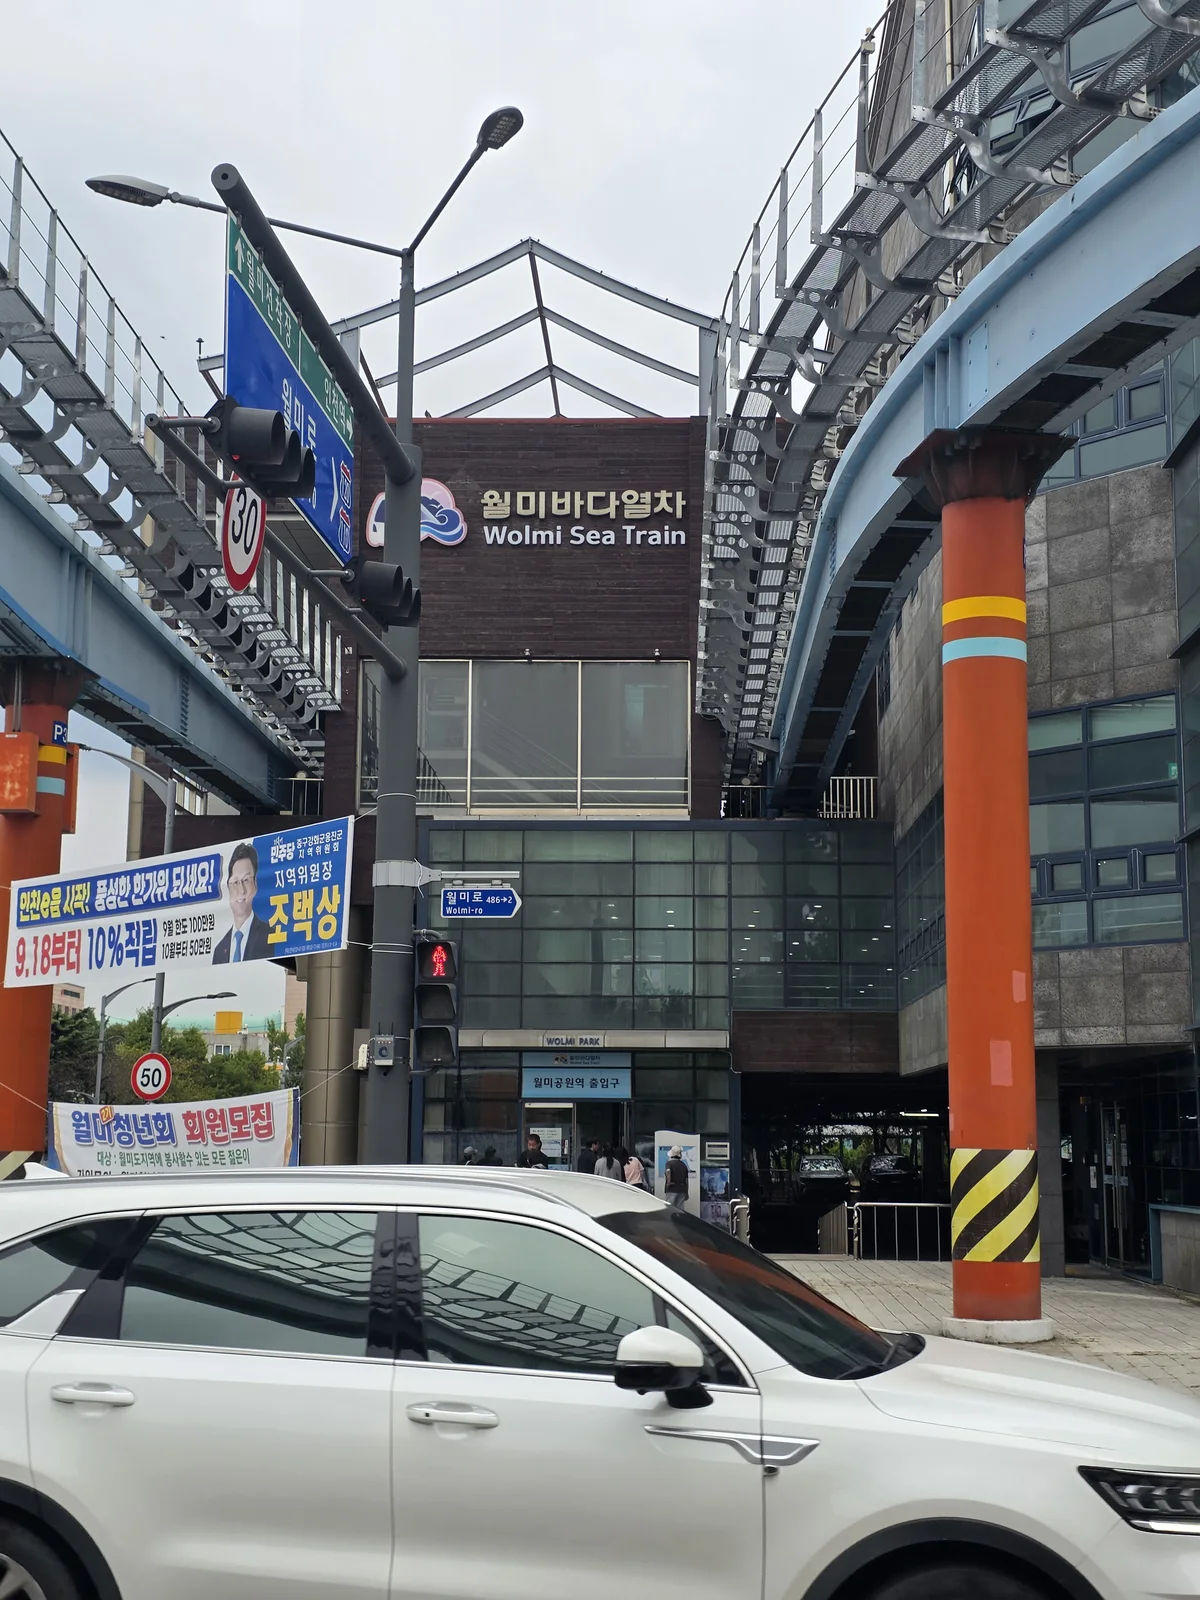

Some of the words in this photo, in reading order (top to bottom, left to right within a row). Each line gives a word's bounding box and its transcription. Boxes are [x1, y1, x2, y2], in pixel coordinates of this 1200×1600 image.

[325, 378, 346, 435] 인천역
[481, 489, 687, 520] 월미바다열차
[231, 487, 258, 556] 30
[483, 525, 562, 546] Wolmi
[569, 525, 616, 546] Sea
[622, 525, 687, 546] Train
[270, 841, 295, 864] 민주당
[298, 842, 340, 859] 지역위원회
[275, 860, 333, 889] 지역위원장
[19, 886, 62, 923] 인천e음
[63, 881, 91, 917] 시작!
[94, 874, 131, 912] 풍성한
[131, 868, 170, 905] 한가위
[170, 859, 215, 899] 되세요!
[446, 891, 483, 905] 월미로
[486, 896, 500, 904] 486
[267, 884, 341, 945] 조택상
[446, 906, 483, 915] Wolmi-ro
[162, 921, 174, 938] 9월
[175, 919, 188, 935] 한도
[188, 913, 215, 934] 100만원
[15, 928, 82, 978] 9.18부터
[88, 917, 157, 970] 10%적립
[161, 940, 188, 960] 10월부터
[189, 936, 212, 956] 50만원
[546, 1037, 575, 1046] WOLMI
[579, 1037, 600, 1046] PARK
[140, 1068, 162, 1088] 50
[533, 1077, 585, 1089] 월미공원역
[589, 1077, 620, 1089] 출입구
[71, 1110, 176, 1147] 월미청년회
[182, 1101, 274, 1144] 회원모집
[97, 1151, 112, 1167] 대상
[119, 1151, 163, 1167] 월미도지역에
[165, 1150, 194, 1167] 봉사할수
[195, 1149, 210, 1167] 있는
[211, 1149, 226, 1166] 모든
